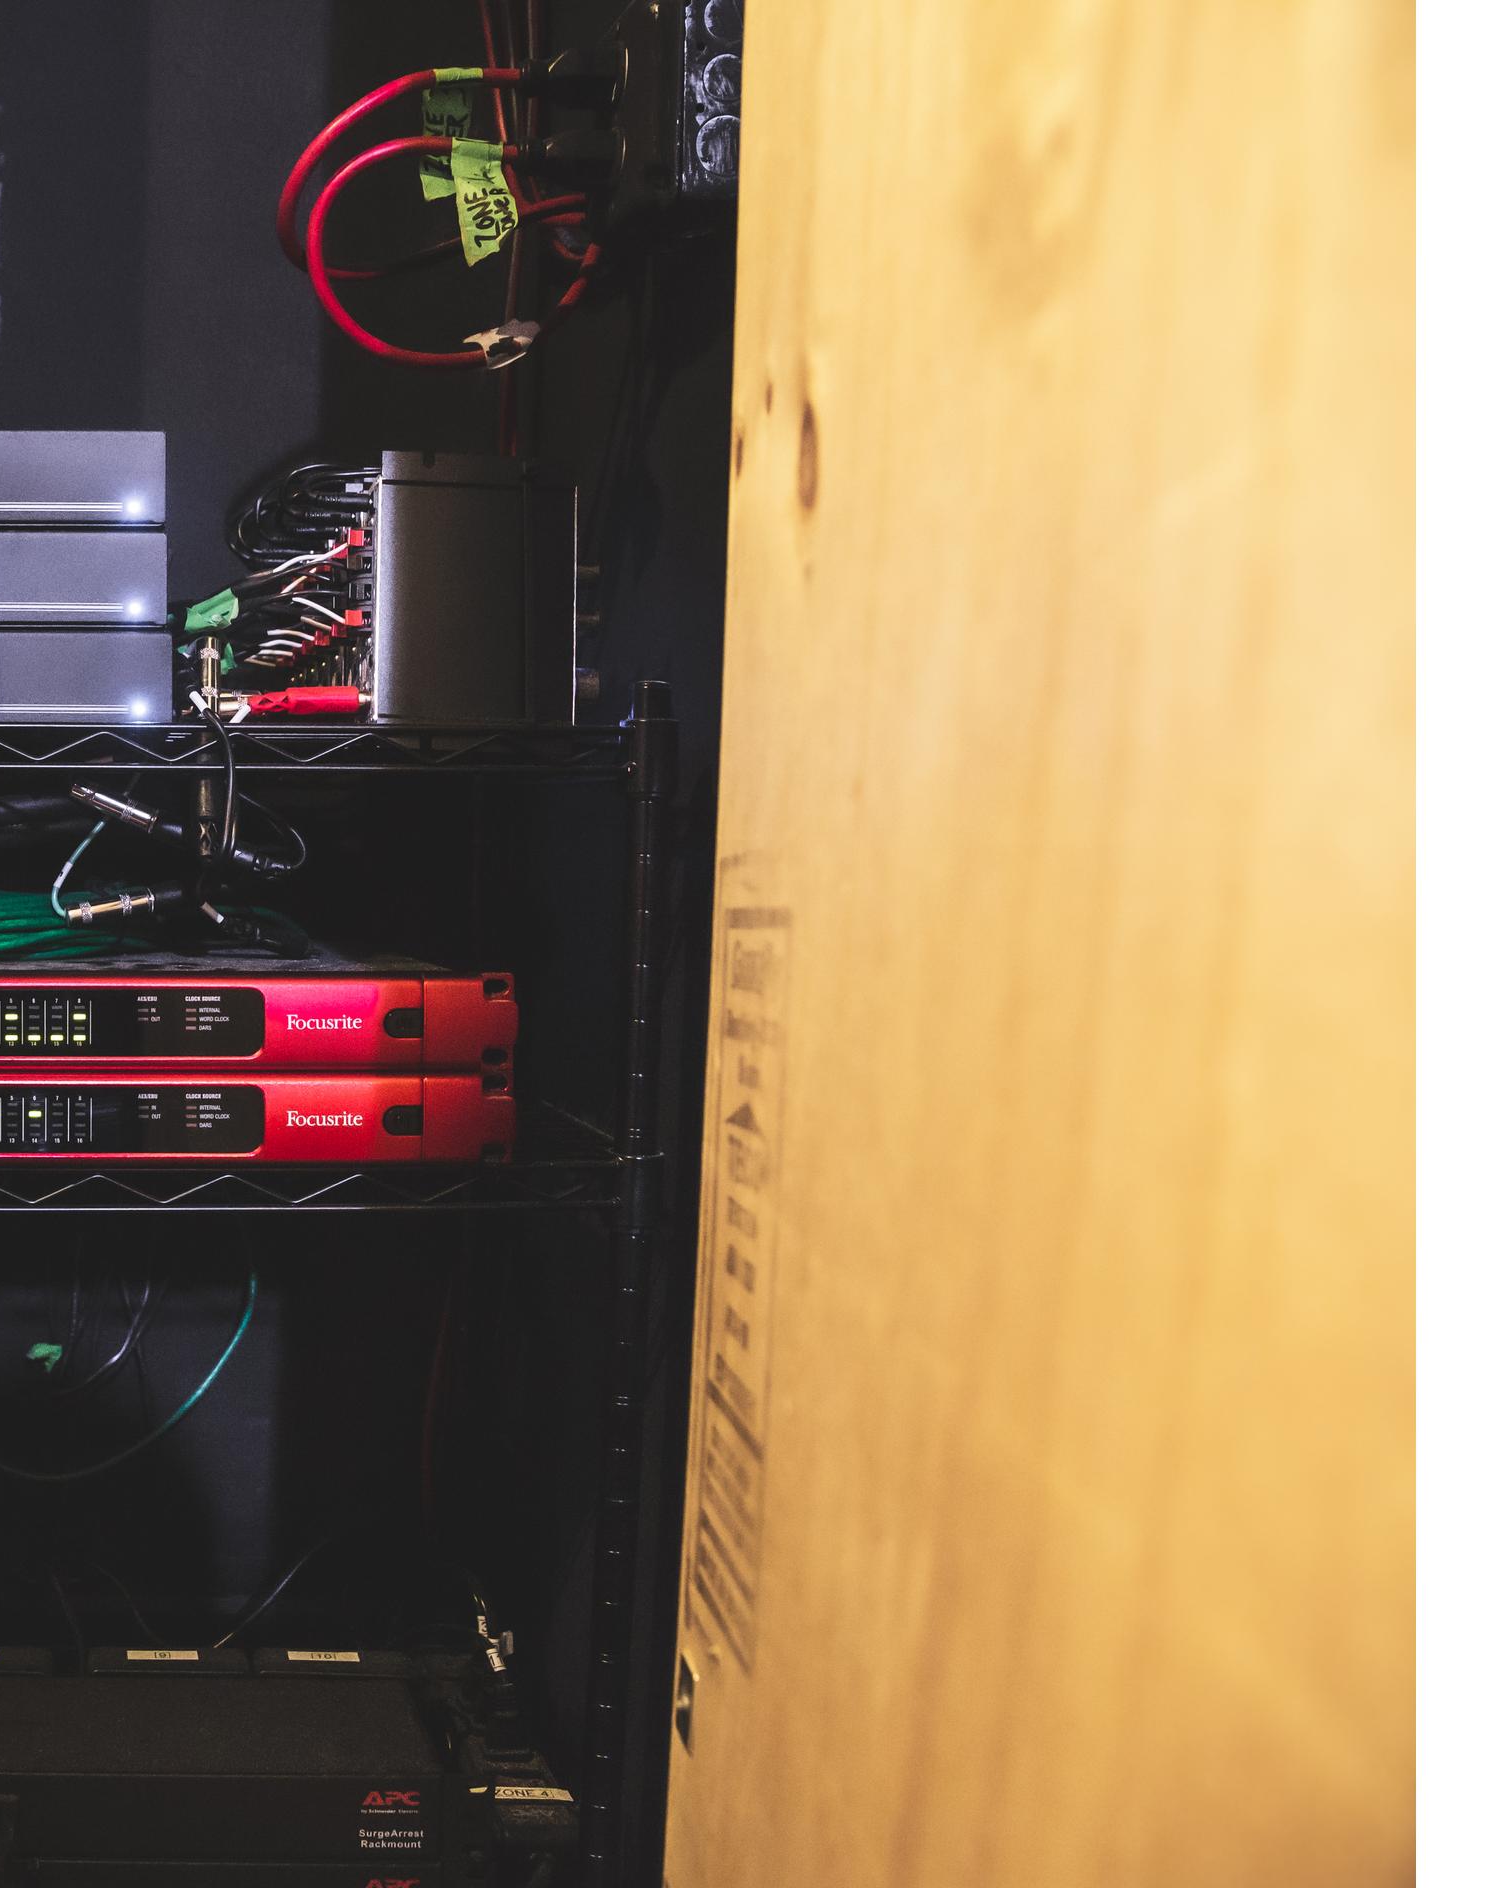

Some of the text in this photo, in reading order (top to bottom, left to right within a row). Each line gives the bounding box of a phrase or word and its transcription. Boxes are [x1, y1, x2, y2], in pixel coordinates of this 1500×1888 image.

[464, 188, 501, 248] ZONE
[286, 1014, 362, 1030] Focusrite
[286, 1110, 363, 1126] Focusrite
[363, 1791, 420, 1806] APC
[358, 1829, 424, 1839] SurgeArrest
[360, 1840, 421, 1848] Rackmount
